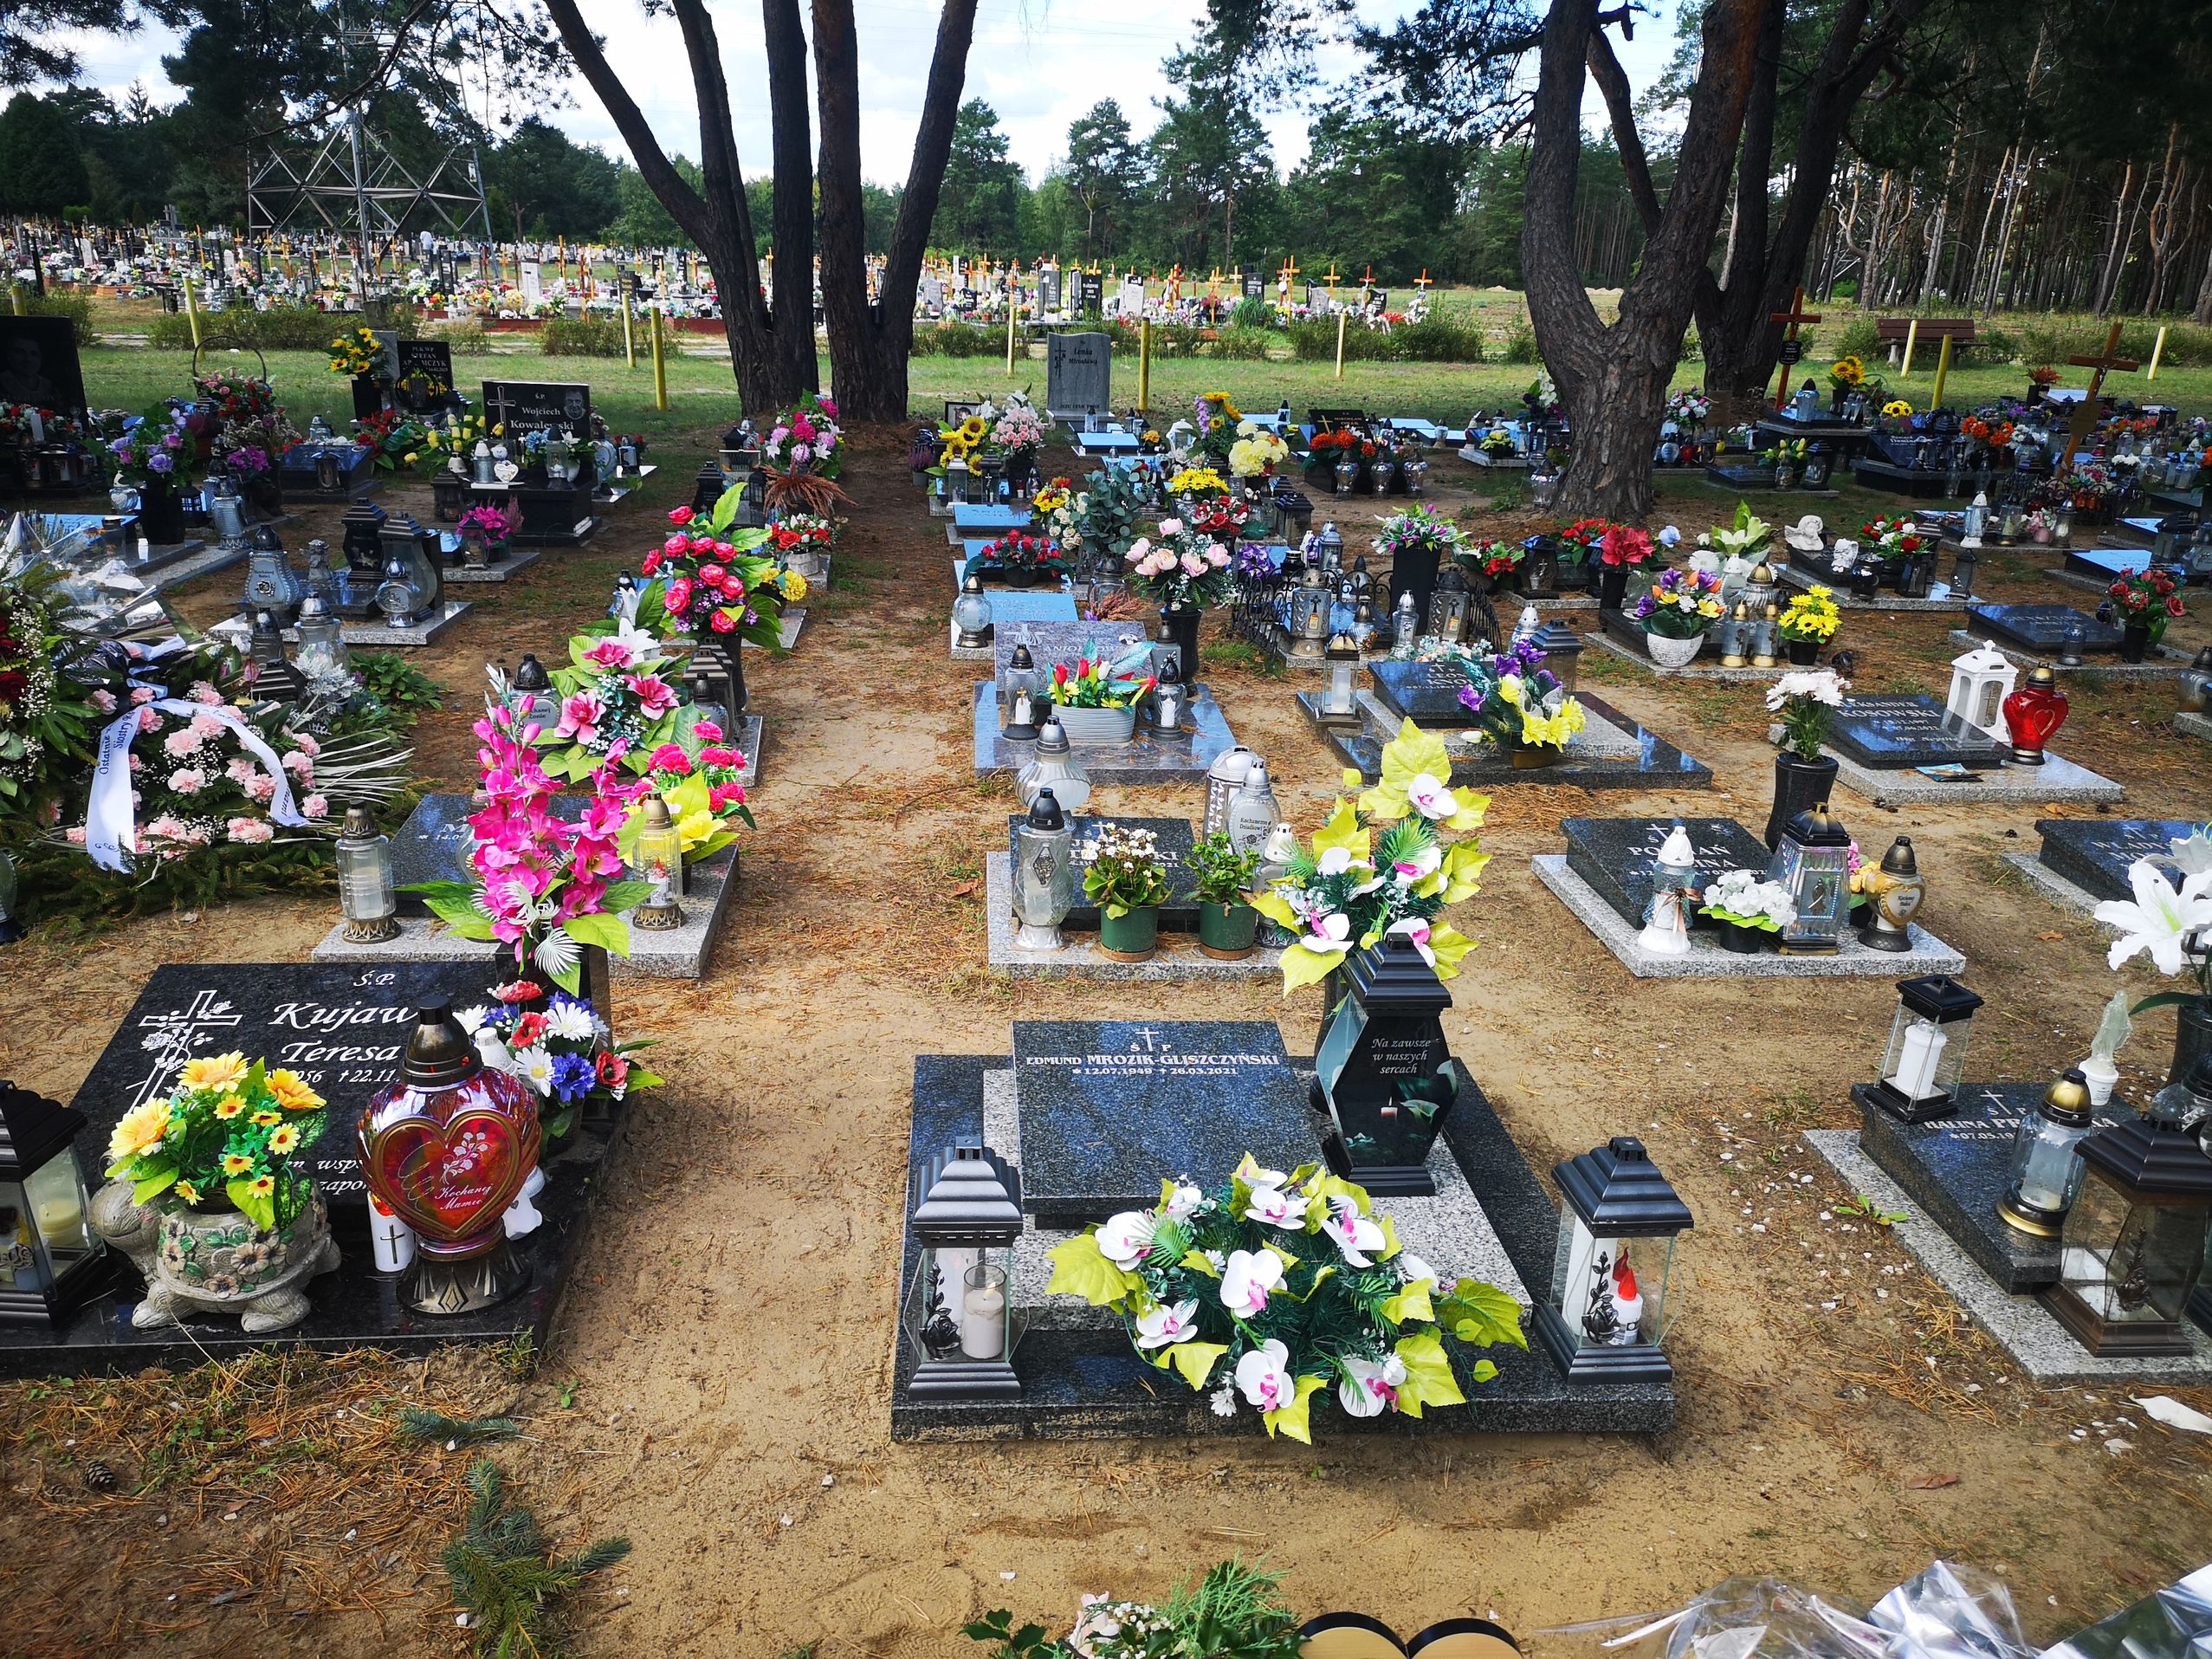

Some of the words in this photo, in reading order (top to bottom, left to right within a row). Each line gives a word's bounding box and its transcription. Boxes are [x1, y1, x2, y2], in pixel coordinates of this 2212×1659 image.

[521, 407, 561, 417] Wojciech
[1837, 710, 1941, 718] KOSOWSKI
[113, 718, 132, 749] Siostry
[1627, 845, 1731, 856] POAŃ
[353, 970, 396, 987] Ś.P.
[268, 1001, 419, 1033] Kujaw
[1161, 1044, 1172, 1053] P
[1371, 1038, 1388, 1049] Na
[1390, 1039, 1432, 1048] zawsze
[281, 1040, 402, 1063] Teresa
[1386, 1049, 1428, 1064] naszych
[1026, 1056, 1082, 1066] EDMUND
[1087, 1052, 1280, 1066] MROZIK-GLISZCZYŃSKI
[1380, 1063, 1418, 1074] sercach
[349, 1069, 401, 1083] 22.11.
[1923, 1120, 1990, 1129] HALINA
[317, 1159, 364, 1175] wsp
[319, 1179, 368, 1196] zapo
[435, 1183, 494, 1200] Kochanej
[439, 1197, 483, 1210] Mamie
